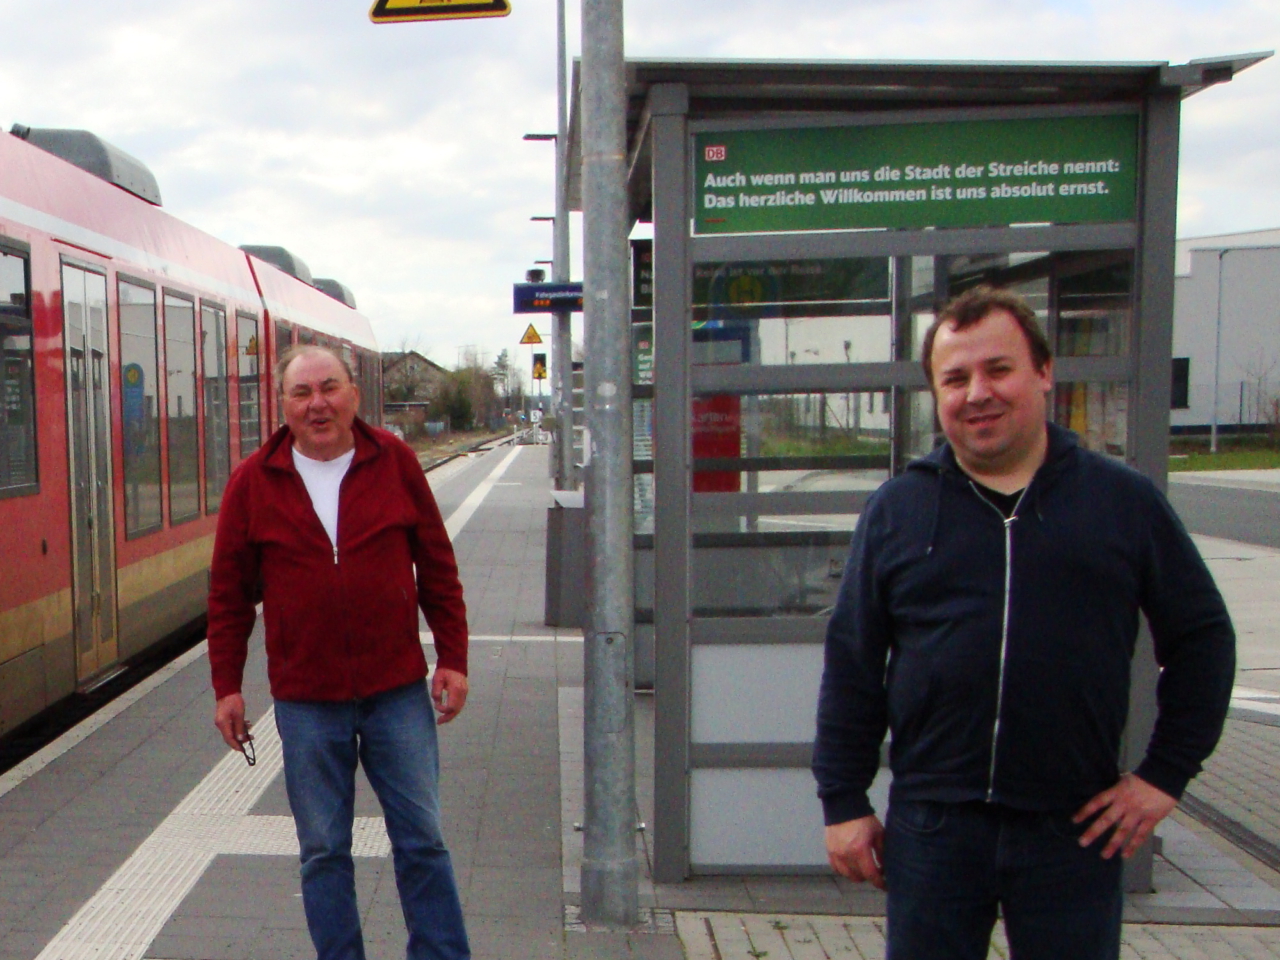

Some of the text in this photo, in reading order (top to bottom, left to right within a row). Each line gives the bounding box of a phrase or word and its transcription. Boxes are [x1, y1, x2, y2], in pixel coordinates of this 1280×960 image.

[705, 147, 726, 160] DB
[704, 159, 1120, 188] Auch wenn man uns die Stadt der Streiche nennt:
[703, 181, 1109, 209] Das herzliche Willkommen ist uns absolut ernst.
